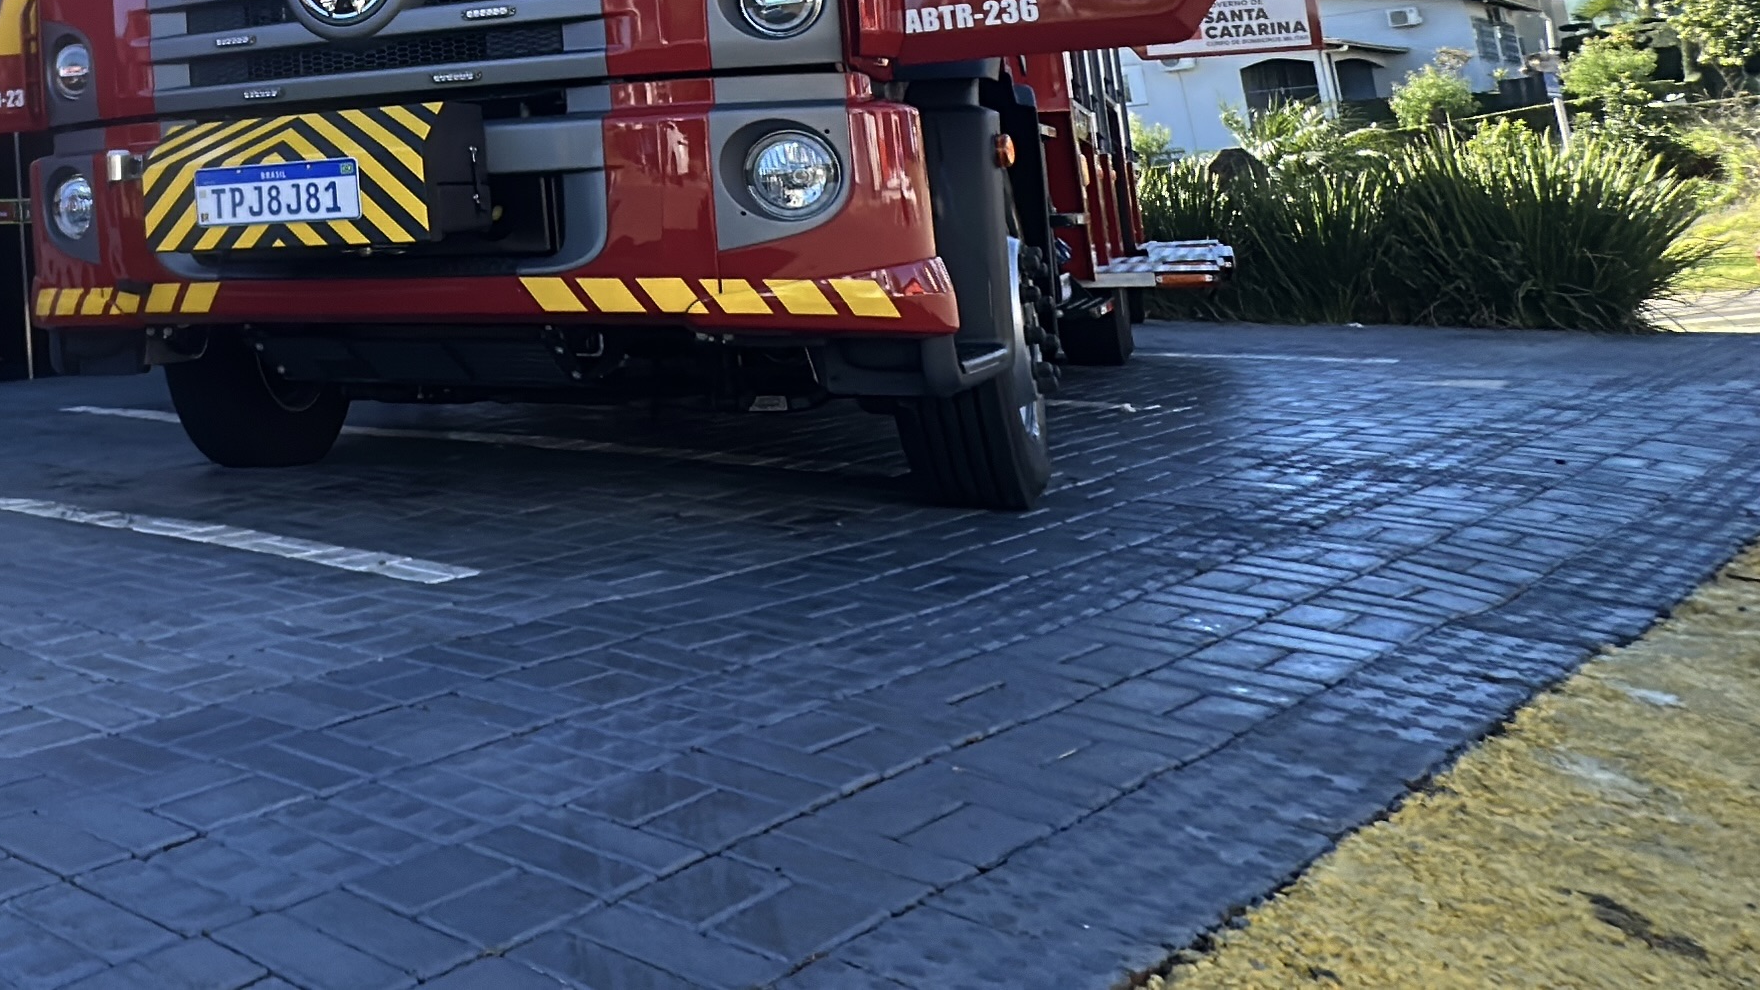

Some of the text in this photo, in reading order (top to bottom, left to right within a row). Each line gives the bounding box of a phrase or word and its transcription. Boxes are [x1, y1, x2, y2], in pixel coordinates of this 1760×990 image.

[1204, 7, 1270, 24] SANTA
[1204, 20, 1308, 39] CATARINA
[260, 170, 287, 180] BRASIL
[210, 180, 342, 220] TPJ8J81
